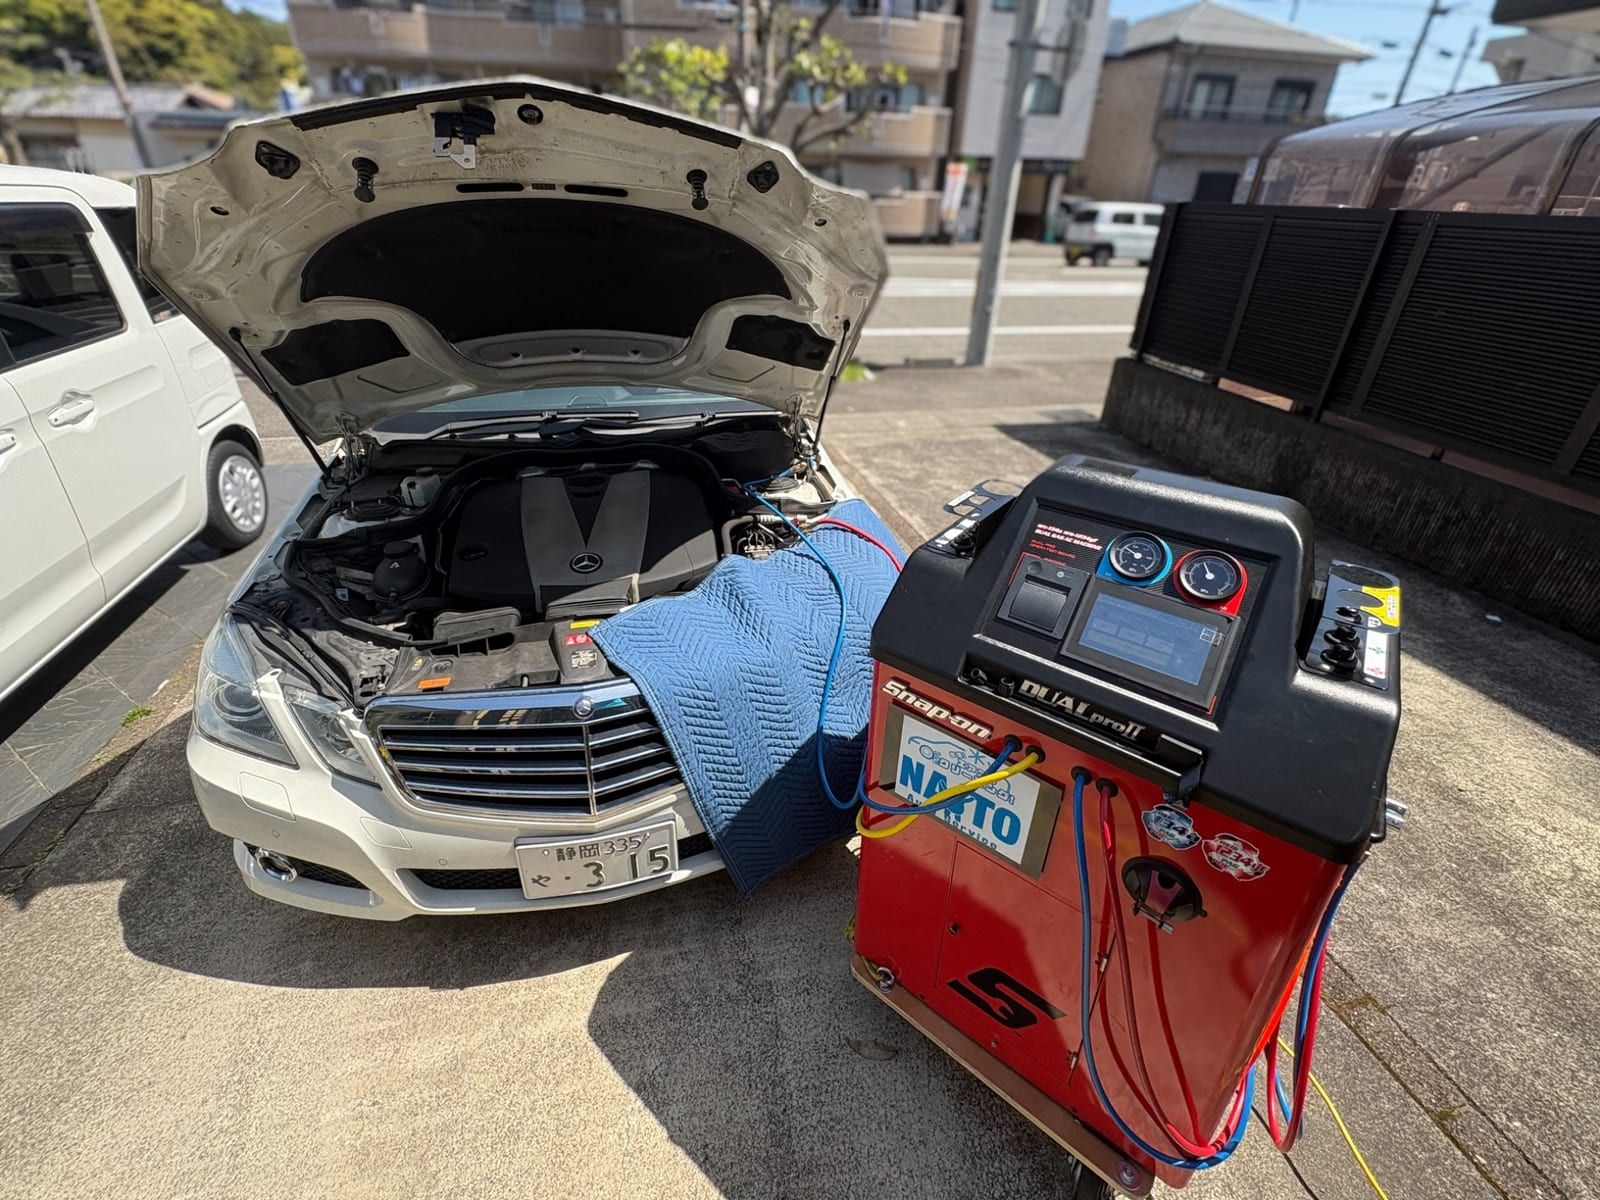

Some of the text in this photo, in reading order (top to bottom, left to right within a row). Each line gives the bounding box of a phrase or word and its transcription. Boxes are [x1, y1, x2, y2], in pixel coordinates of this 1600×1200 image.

[881, 678, 992, 742] Snap-on
[900, 755, 1021, 846] NATO
[556, 834, 643, 862] 静岡 335
[531, 874, 551, 888] や
